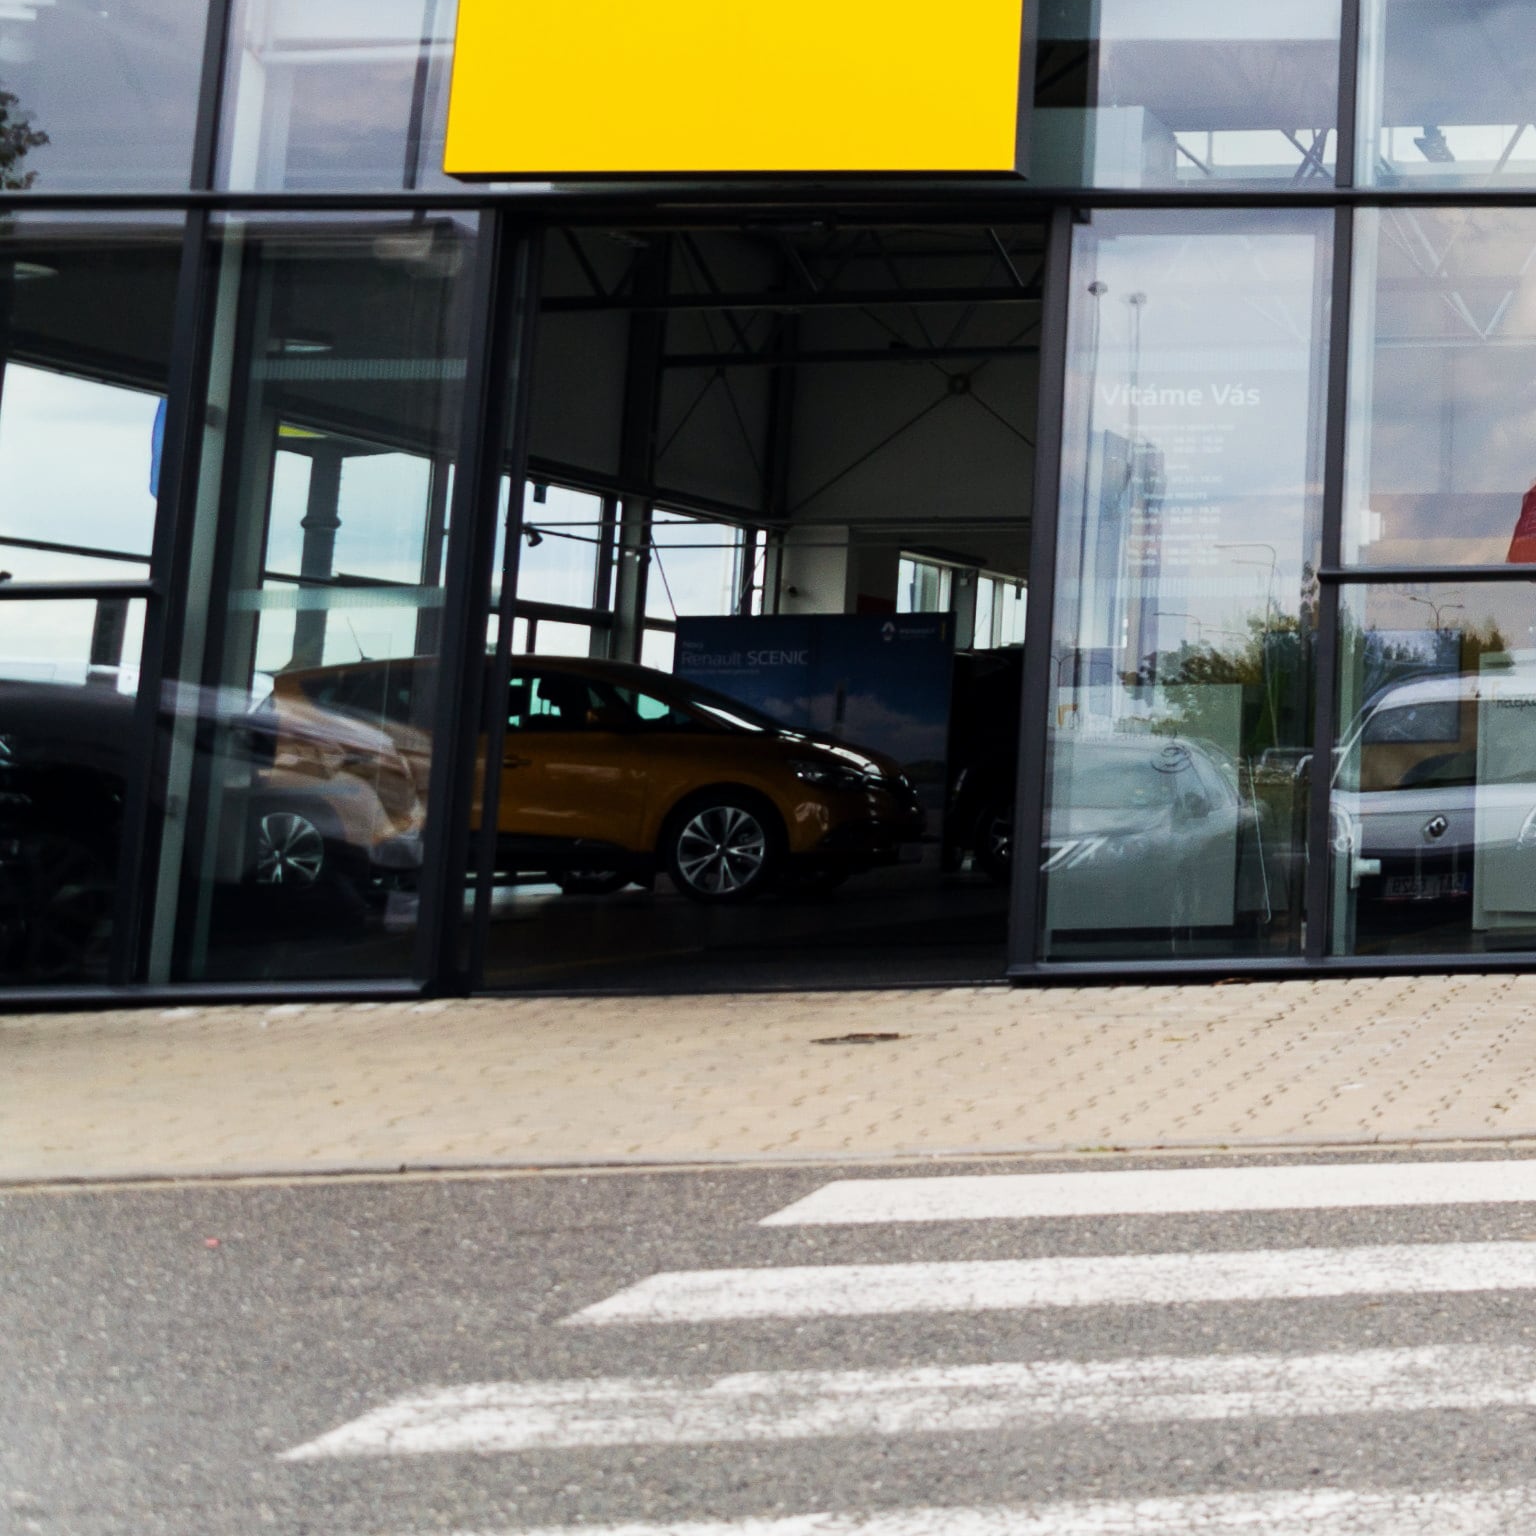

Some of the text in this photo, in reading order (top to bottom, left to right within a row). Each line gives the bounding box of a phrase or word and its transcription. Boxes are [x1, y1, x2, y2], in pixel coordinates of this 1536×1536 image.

[1101, 382, 1261, 406] Vítáme Vás
[746, 649, 809, 666] SCENIC
